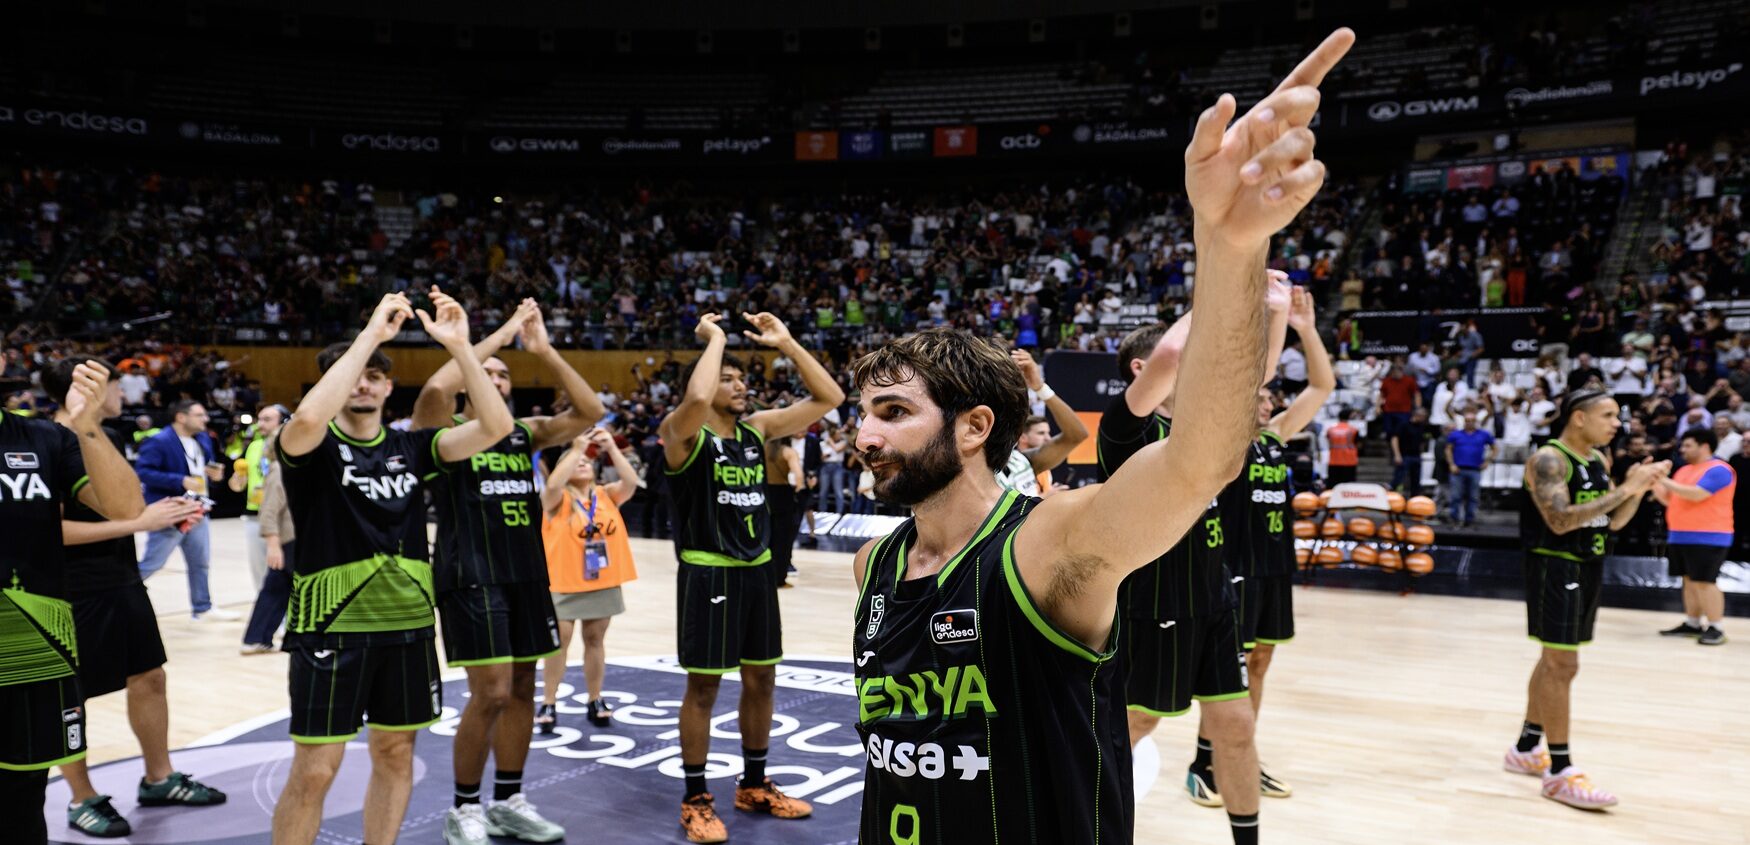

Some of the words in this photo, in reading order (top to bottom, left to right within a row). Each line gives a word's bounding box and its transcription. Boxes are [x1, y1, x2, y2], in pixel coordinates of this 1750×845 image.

[1640, 68, 1728, 96] pelayo
[1403, 95, 1480, 116] GWM
[24, 107, 148, 135] endesa
[203, 131, 283, 144] BADALONA
[341, 131, 441, 151] endesa
[519, 137, 581, 152] GWM
[703, 136, 762, 155] pelayo
[999, 132, 1042, 150] acb
[0, 472, 52, 501] YA
[501, 501, 531, 527] 55
[1266, 510, 1284, 533] 16
[743, 514, 756, 539] 1
[934, 621, 953, 632] liga
[936, 628, 975, 640] endesa
[866, 732, 946, 780] sisa
[889, 803, 920, 845] 9
